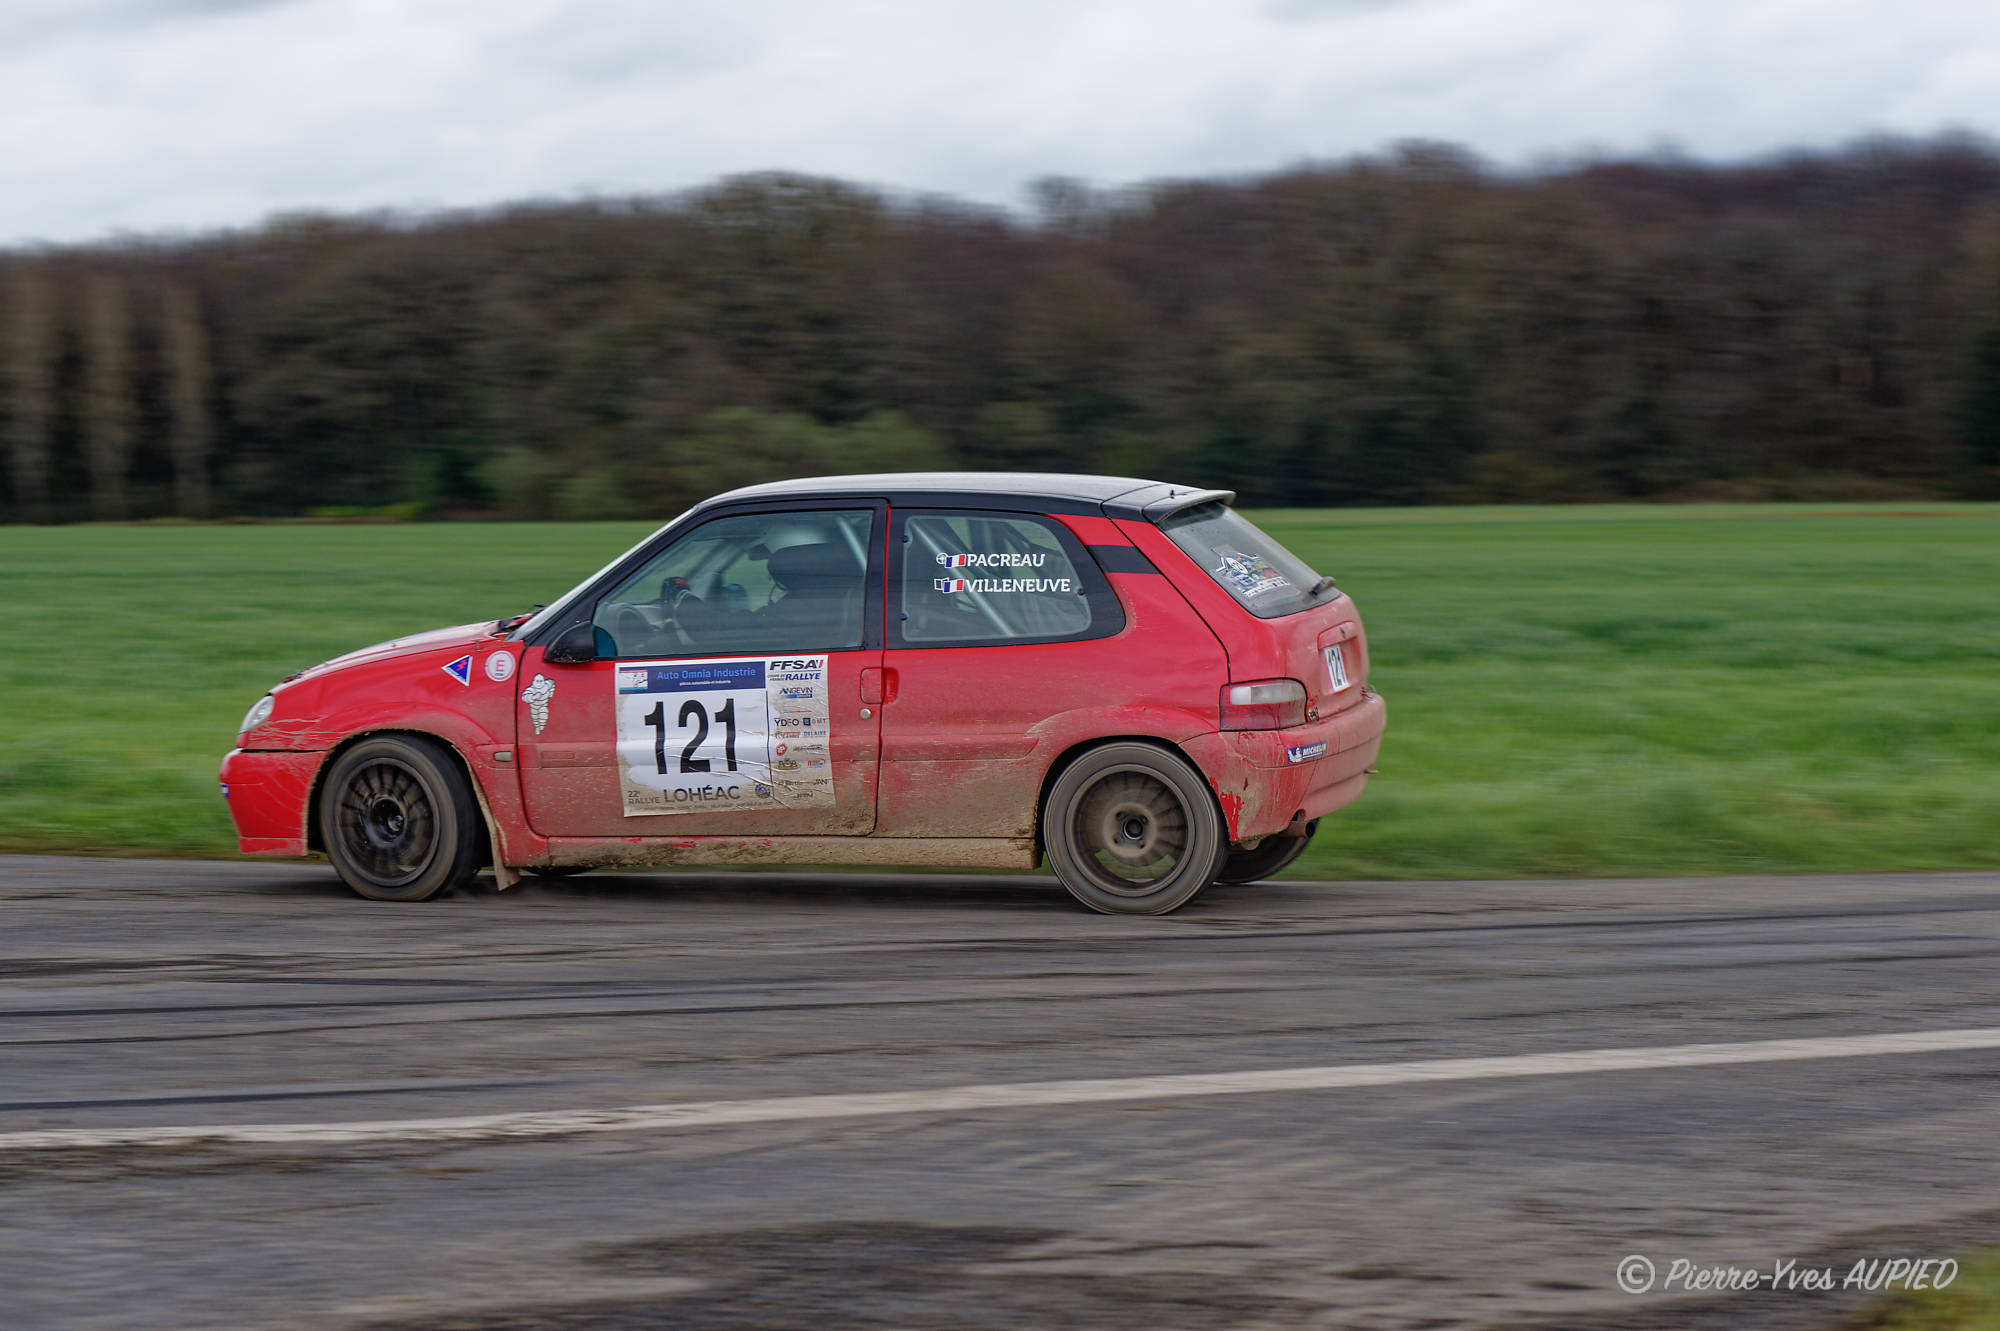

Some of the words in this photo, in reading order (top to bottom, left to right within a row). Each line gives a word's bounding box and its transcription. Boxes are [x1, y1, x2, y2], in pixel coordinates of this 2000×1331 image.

[967, 553, 1045, 567] PACREAU
[966, 579, 1071, 592] VILLENEUVE
[770, 659, 818, 670] FFSA
[1326, 647, 1347, 688] 121
[656, 670, 679, 680] Auto
[681, 669, 711, 679] Omnia
[713, 667, 757, 677] Industrie
[785, 672, 821, 681] RALLYE
[644, 698, 738, 775] 121
[1302, 743, 1327, 756] MICHELIN
[628, 796, 661, 804] RALLYE
[663, 785, 740, 802] LOHÉAC
